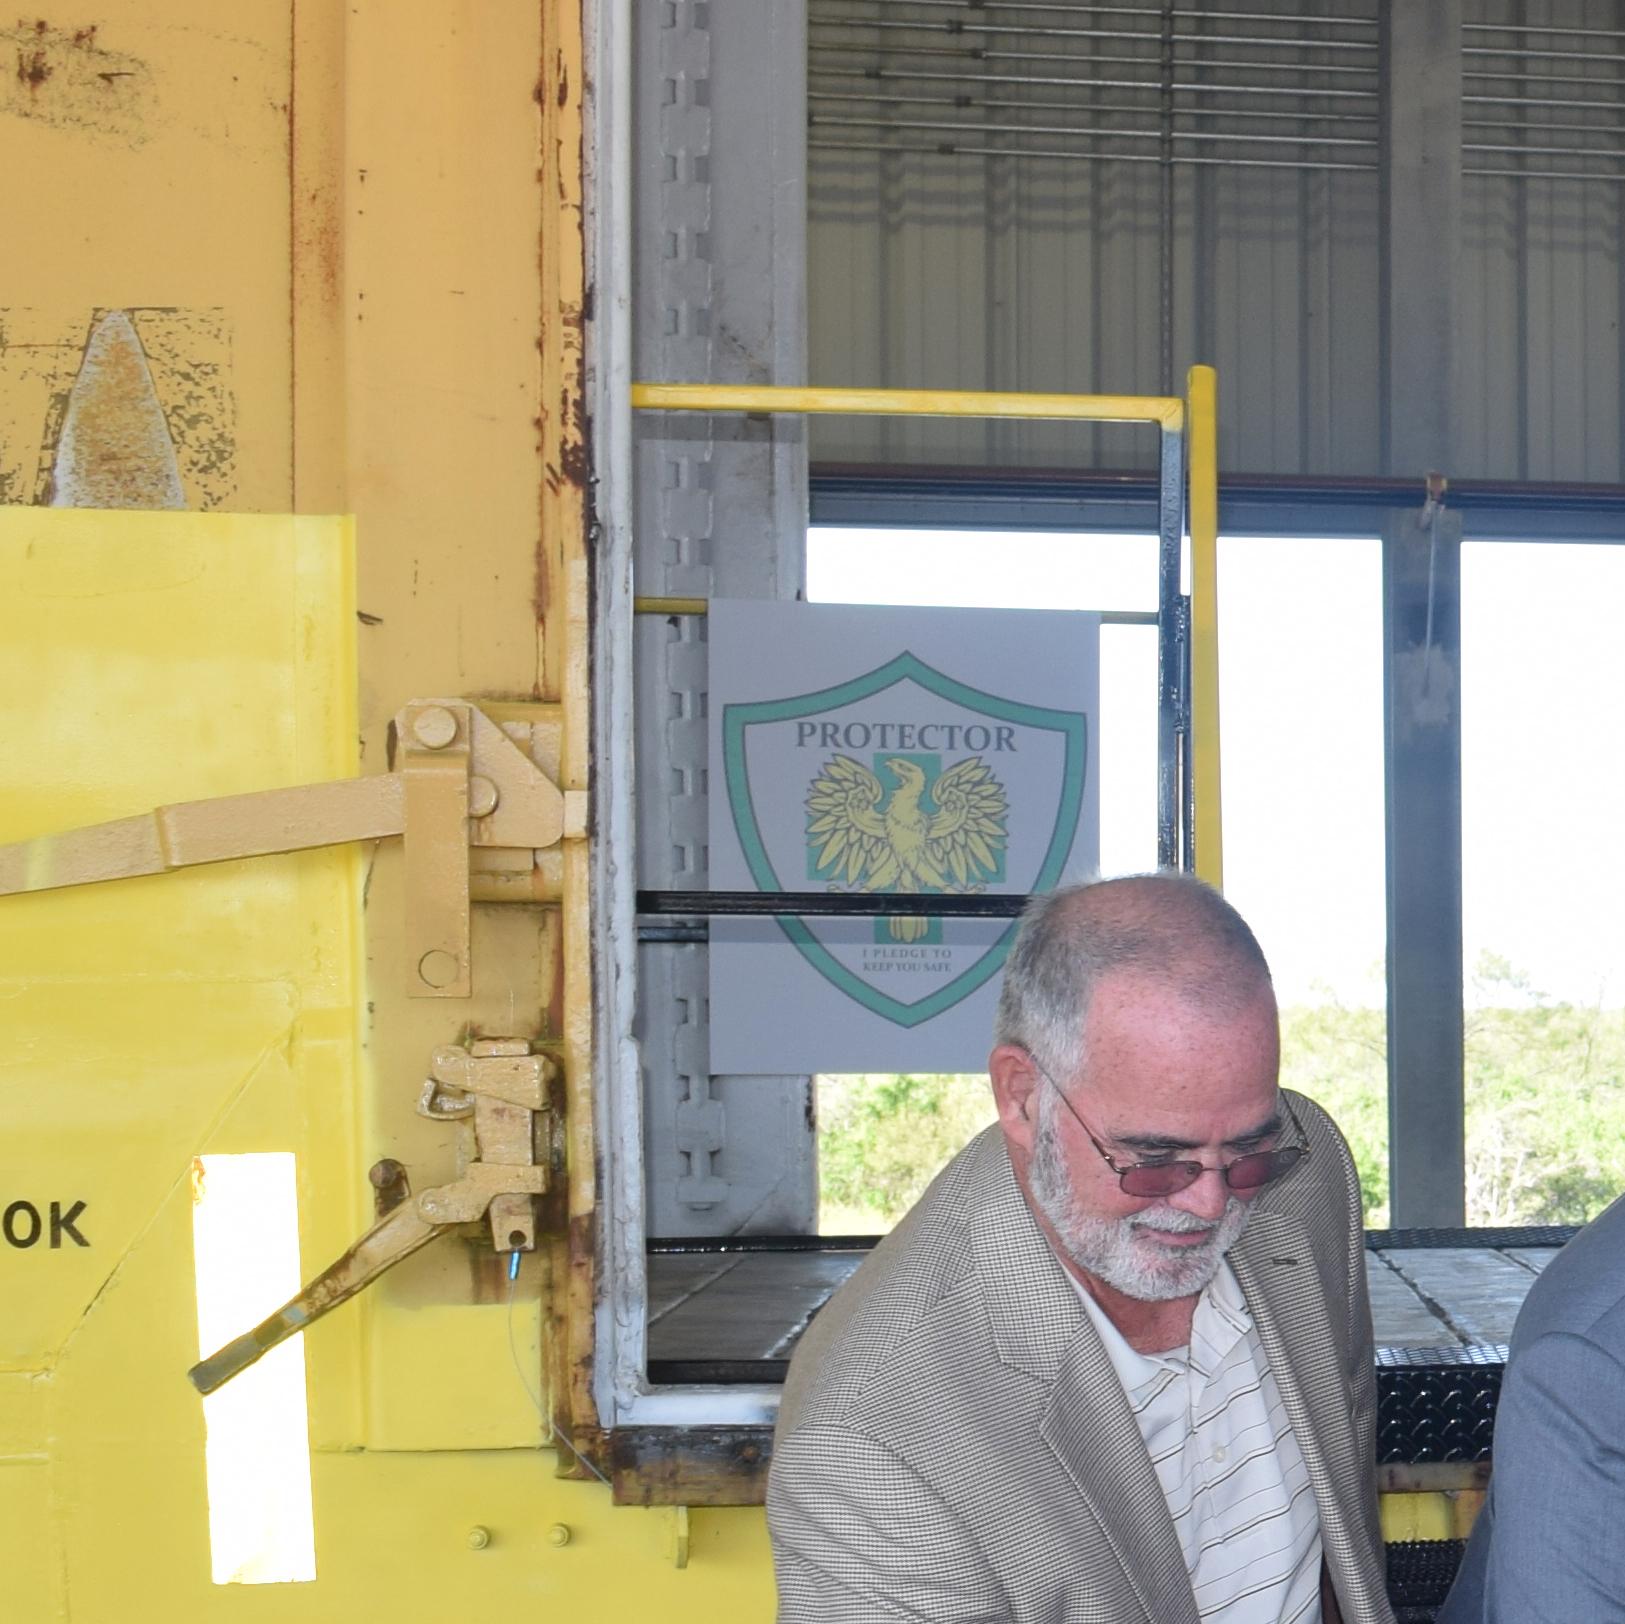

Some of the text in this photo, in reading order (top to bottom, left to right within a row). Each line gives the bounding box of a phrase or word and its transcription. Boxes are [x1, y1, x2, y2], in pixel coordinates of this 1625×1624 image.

[796, 721, 1018, 752] PROTECTOR
[874, 949, 928, 958] PLEDGE
[932, 949, 952, 958] TO
[863, 963, 894, 972] KEEP
[896, 963, 920, 972] YOU
[3, 1200, 90, 1249] OK
